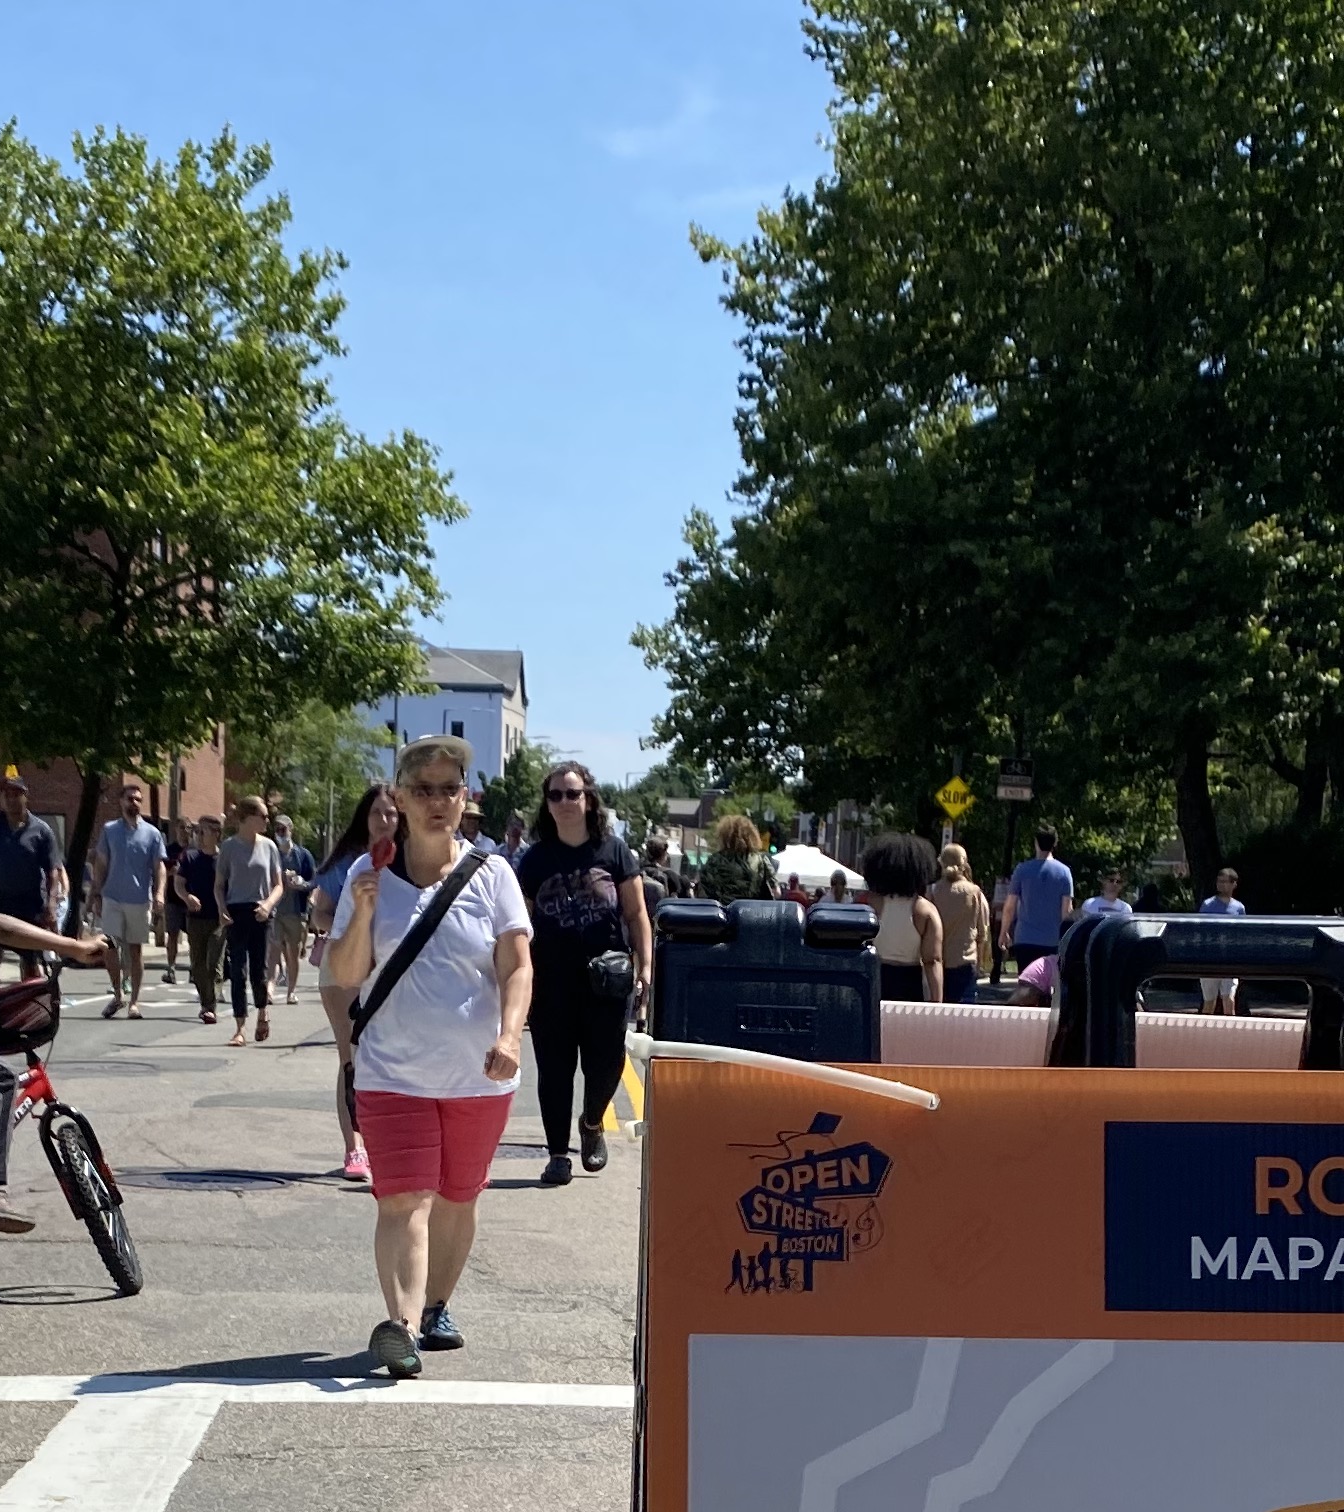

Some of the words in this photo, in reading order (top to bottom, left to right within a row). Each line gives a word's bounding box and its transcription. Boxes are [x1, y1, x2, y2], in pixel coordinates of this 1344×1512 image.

[942, 790, 968, 804] SLOW
[765, 1153, 870, 1195] OPEN
[781, 1233, 838, 1253] BOSTON
